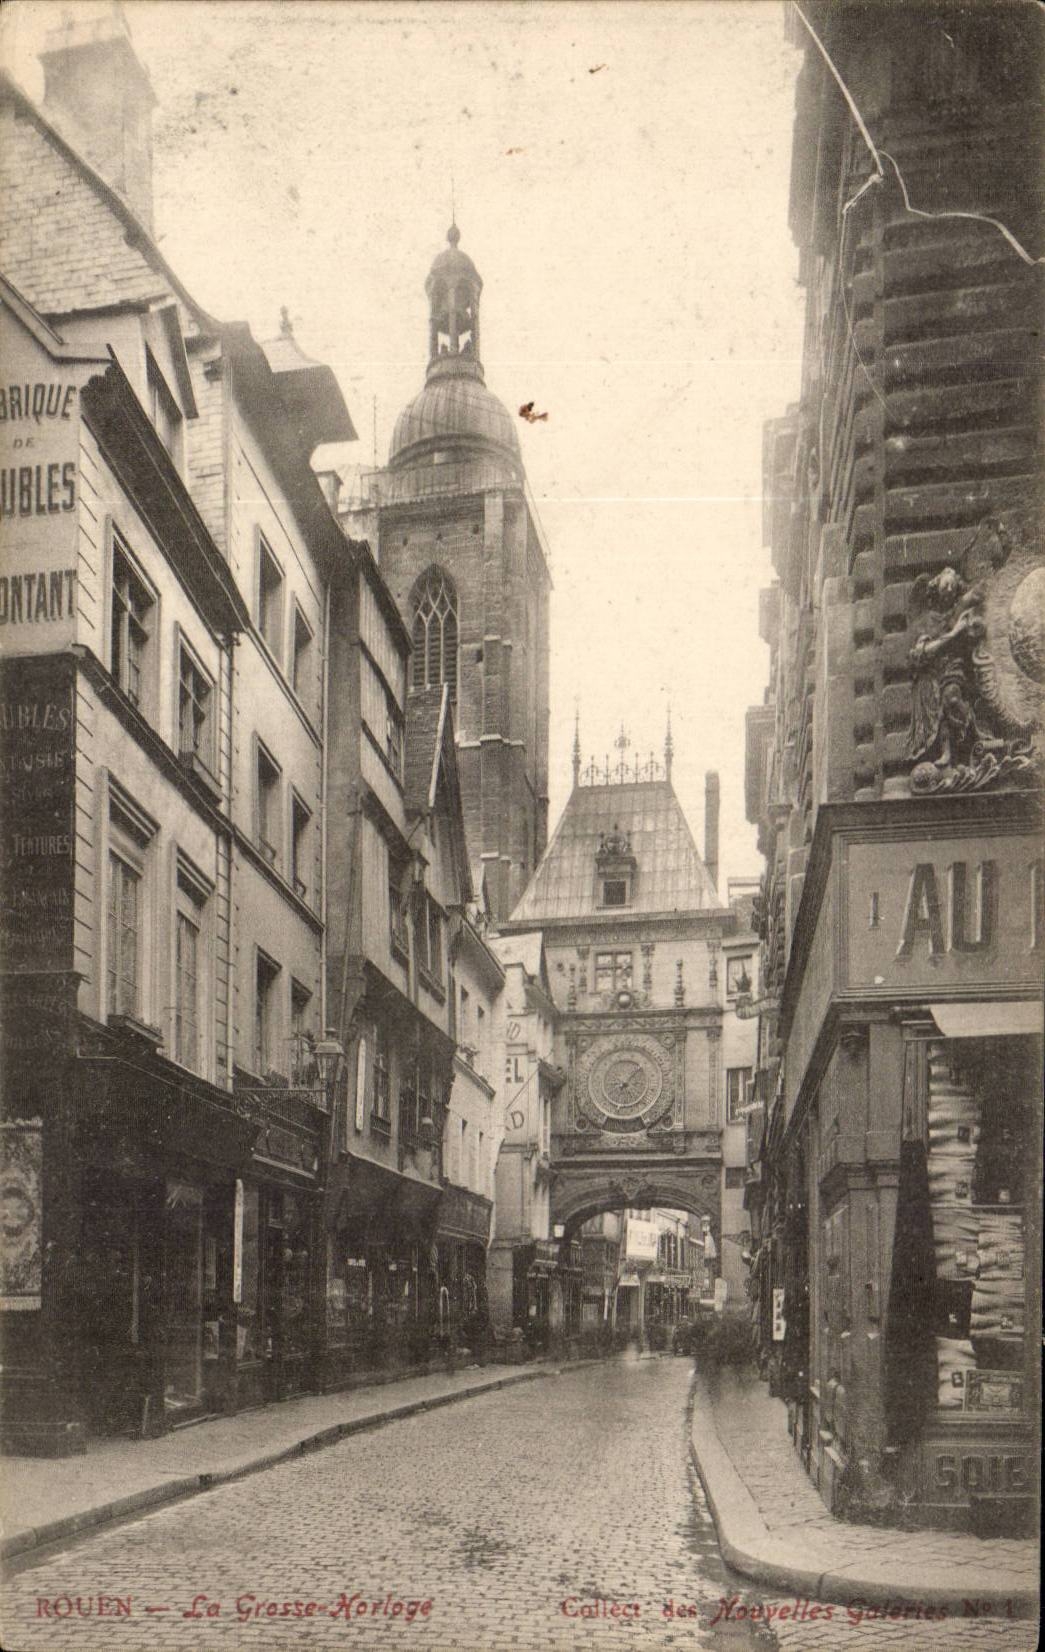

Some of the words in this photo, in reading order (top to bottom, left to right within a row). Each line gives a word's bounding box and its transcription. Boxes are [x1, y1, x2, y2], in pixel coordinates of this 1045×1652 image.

[13, 437, 34, 449] DE
[0, 570, 77, 625] ONTANT
[897, 861, 995, 956] AU
